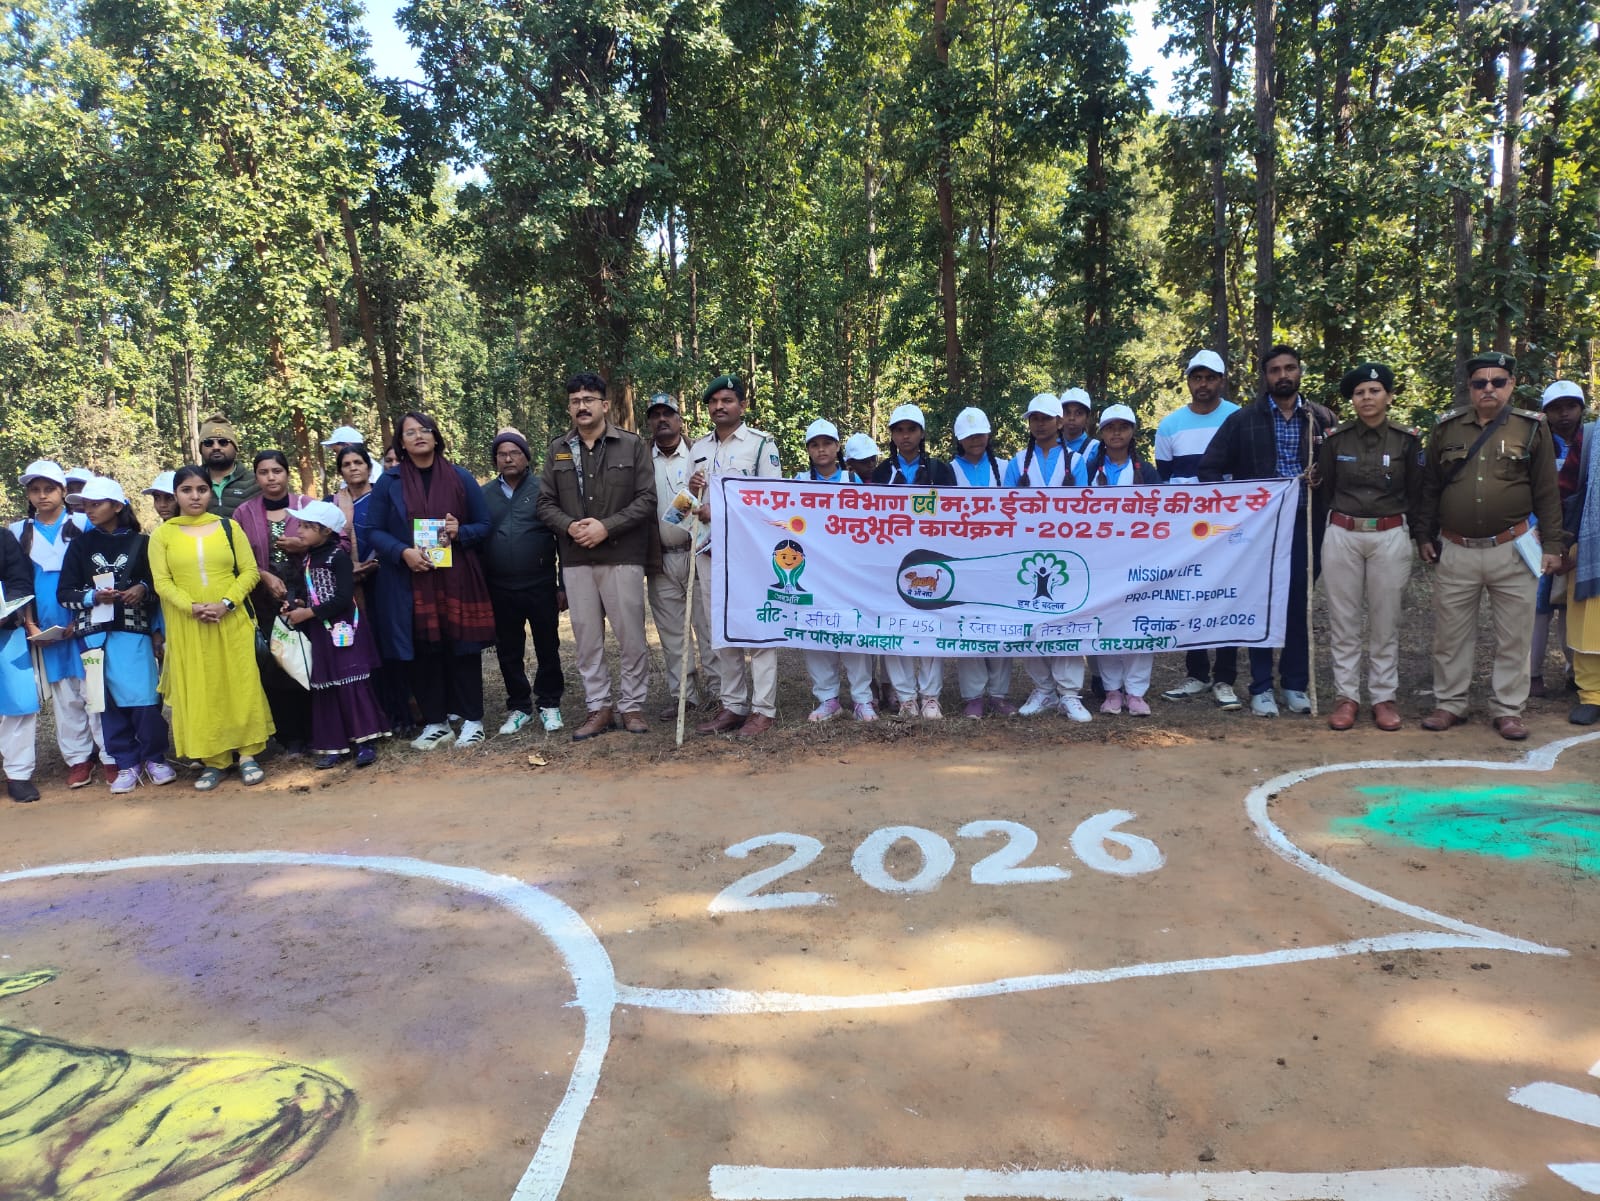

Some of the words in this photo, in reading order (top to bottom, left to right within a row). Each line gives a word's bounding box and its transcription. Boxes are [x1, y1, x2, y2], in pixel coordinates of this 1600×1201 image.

[800, 491, 833, 510] वन
[836, 488, 908, 512] विभाग
[912, 489, 936, 514] एवं
[1000, 491, 1049, 521] ईको
[1052, 489, 1118, 515] पर्यटन
[1121, 489, 1162, 518] बोर्ड
[1163, 491, 1193, 514] की
[1193, 489, 1240, 514] ओर
[1245, 487, 1272, 512] से
[825, 513, 916, 545] अनुभूति
[919, 511, 1017, 541] कार्यक्रम
[1177, 563, 1203, 577] LIFE
[783, 627, 806, 641] वन
[936, 638, 959, 652] वन
[707, 808, 1167, 917] 2026
